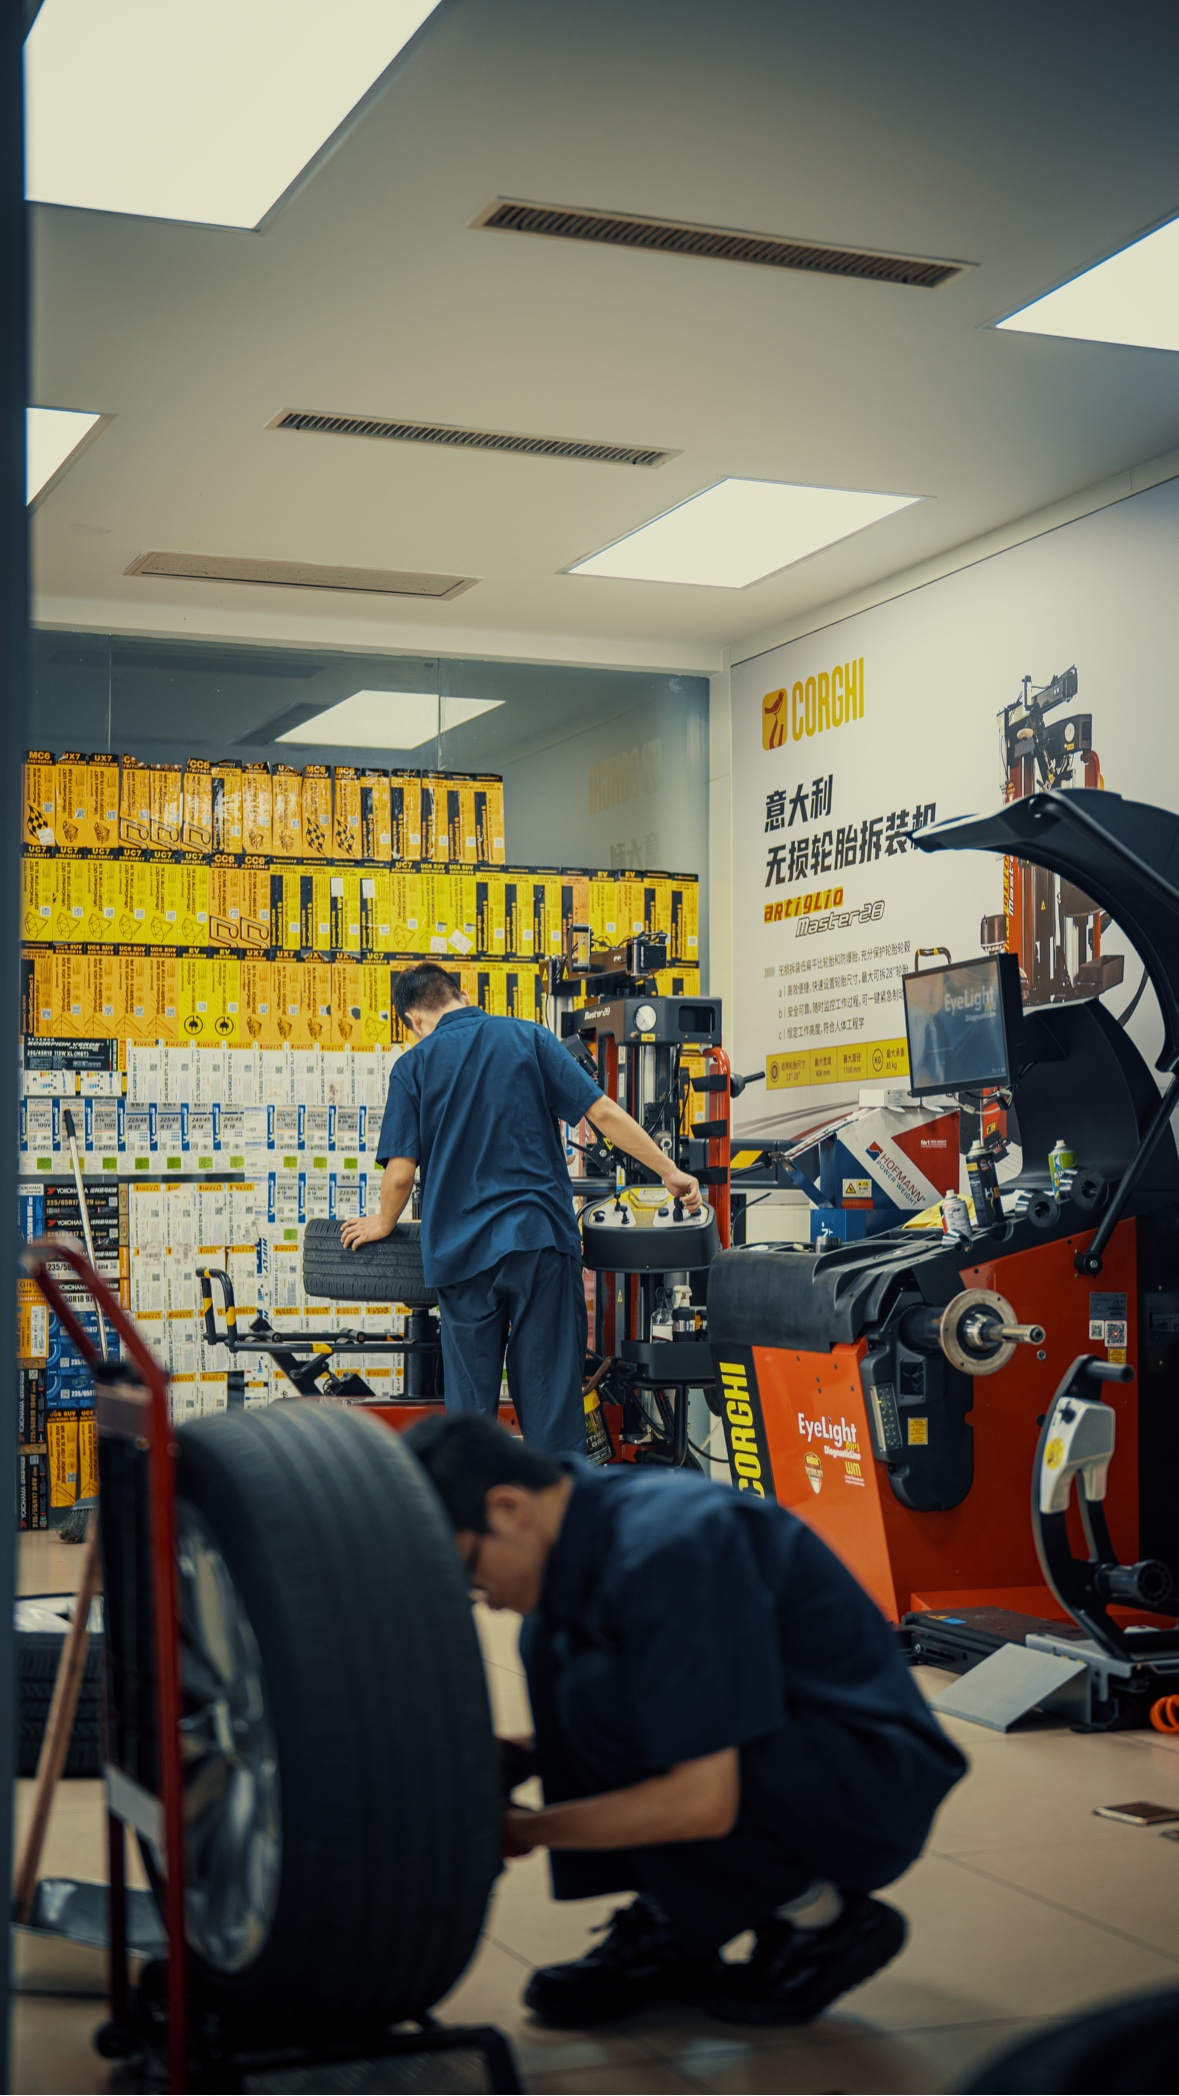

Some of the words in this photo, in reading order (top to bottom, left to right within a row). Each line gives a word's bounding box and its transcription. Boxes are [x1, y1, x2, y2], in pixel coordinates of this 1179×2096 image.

[792, 657, 864, 741] CORGHI
[764, 774, 833, 832] 意大利
[214, 855, 234, 863] CC6
[245, 856, 265, 865] CC6
[765, 802, 936, 888] 无损轮胎拆装机
[795, 900, 885, 938] Master28
[945, 985, 994, 1016] EyeLight
[876, 1160, 898, 1184] POWER
[896, 1183, 918, 1206] WEIGHT
[880, 1154, 924, 1203] HOFMANN
[720, 1362, 765, 1499] CORGHI
[798, 1412, 856, 1447] EyeLight
